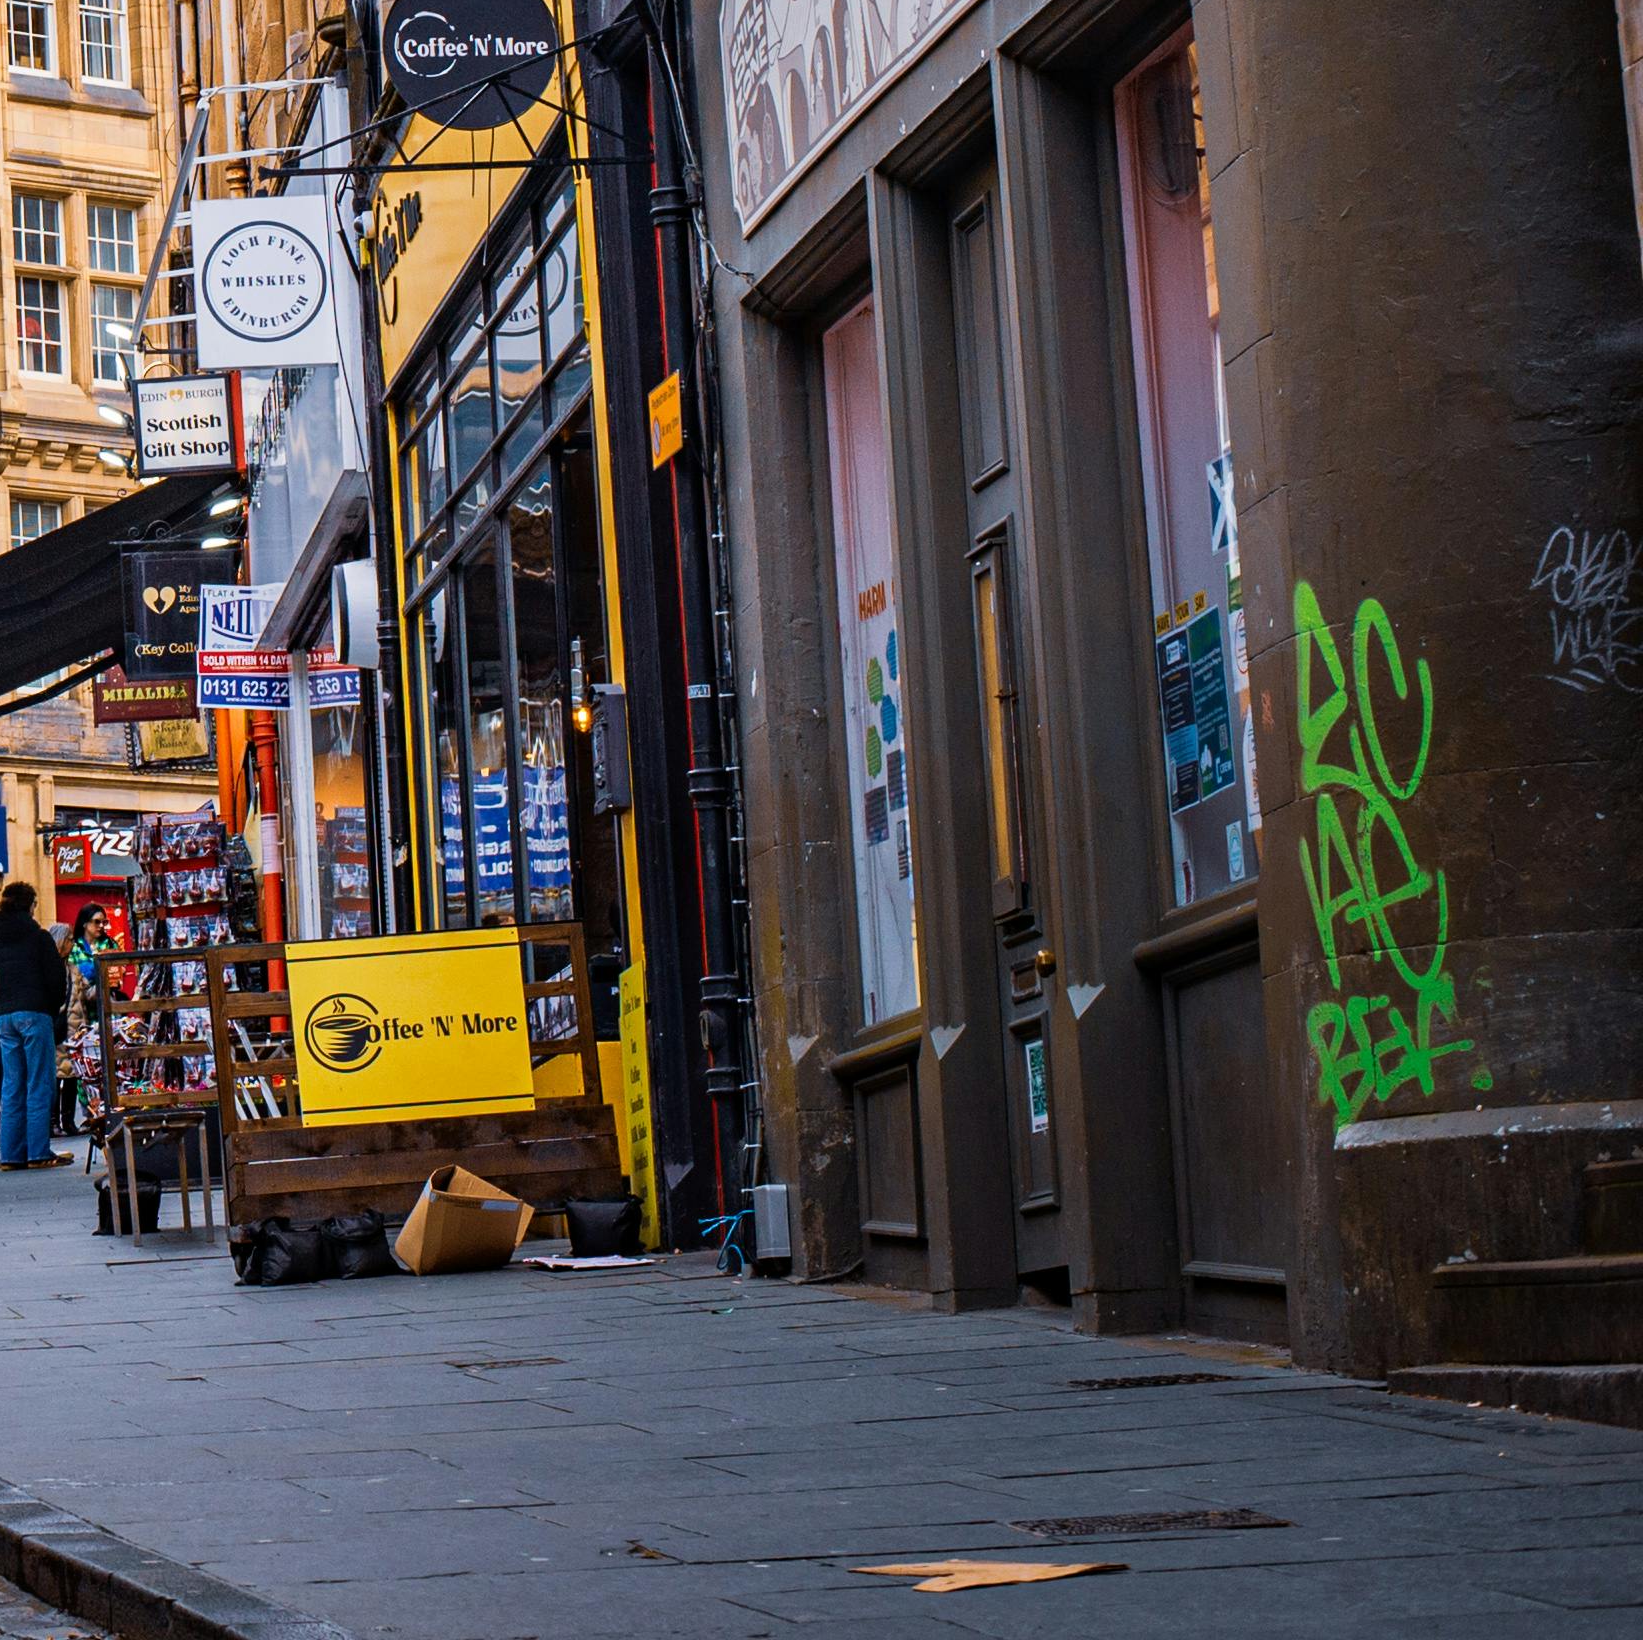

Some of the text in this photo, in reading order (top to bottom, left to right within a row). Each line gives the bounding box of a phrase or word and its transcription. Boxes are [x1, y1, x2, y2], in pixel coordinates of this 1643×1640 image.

[403, 37, 468, 57] Coffee
[495, 37, 549, 56] More
[221, 235, 306, 267] LOCH FYNE
[220, 274, 306, 288] WHISKIES
[222, 295, 309, 328] EDINBURGH
[140, 388, 223, 403] EDIN BURGH
[146, 414, 222, 433] Scottish
[144, 440, 230, 458] Gift Shop
[203, 655, 225, 666] SOLD
[226, 655, 257, 666] WITHIN
[259, 655, 269, 665] 14
[203, 679, 237, 695] 0131
[241, 680, 268, 697] 625
[57, 846, 84, 861] Pizza
[60, 861, 79, 874] Hut
[462, 1013, 518, 1035] More
